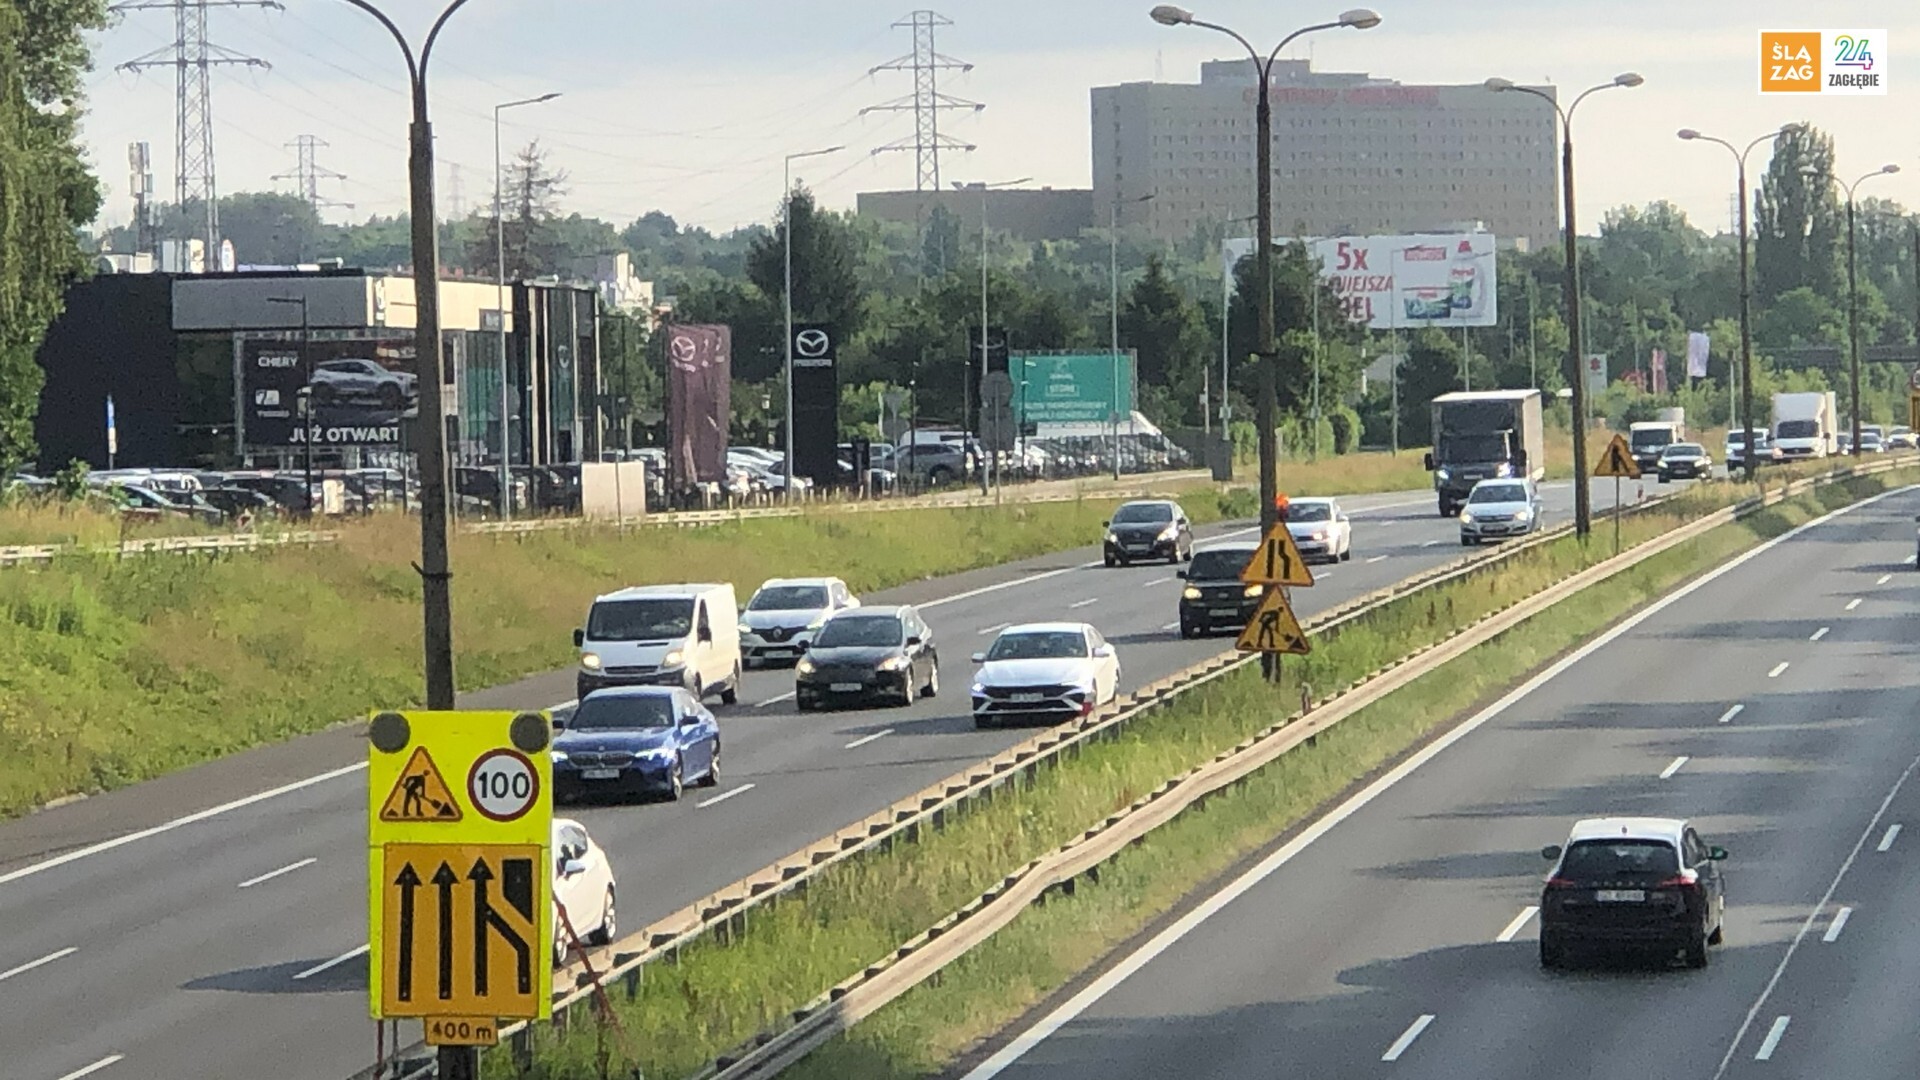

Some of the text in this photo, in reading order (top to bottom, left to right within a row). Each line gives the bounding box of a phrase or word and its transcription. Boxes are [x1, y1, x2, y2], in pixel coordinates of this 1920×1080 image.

[1336, 241, 1369, 271] 5x
[258, 356, 298, 367] CHERY
[289, 425, 399, 443] JUŻ OTWART
[478, 771, 530, 799] 100
[433, 1021, 492, 1040] 400 m
